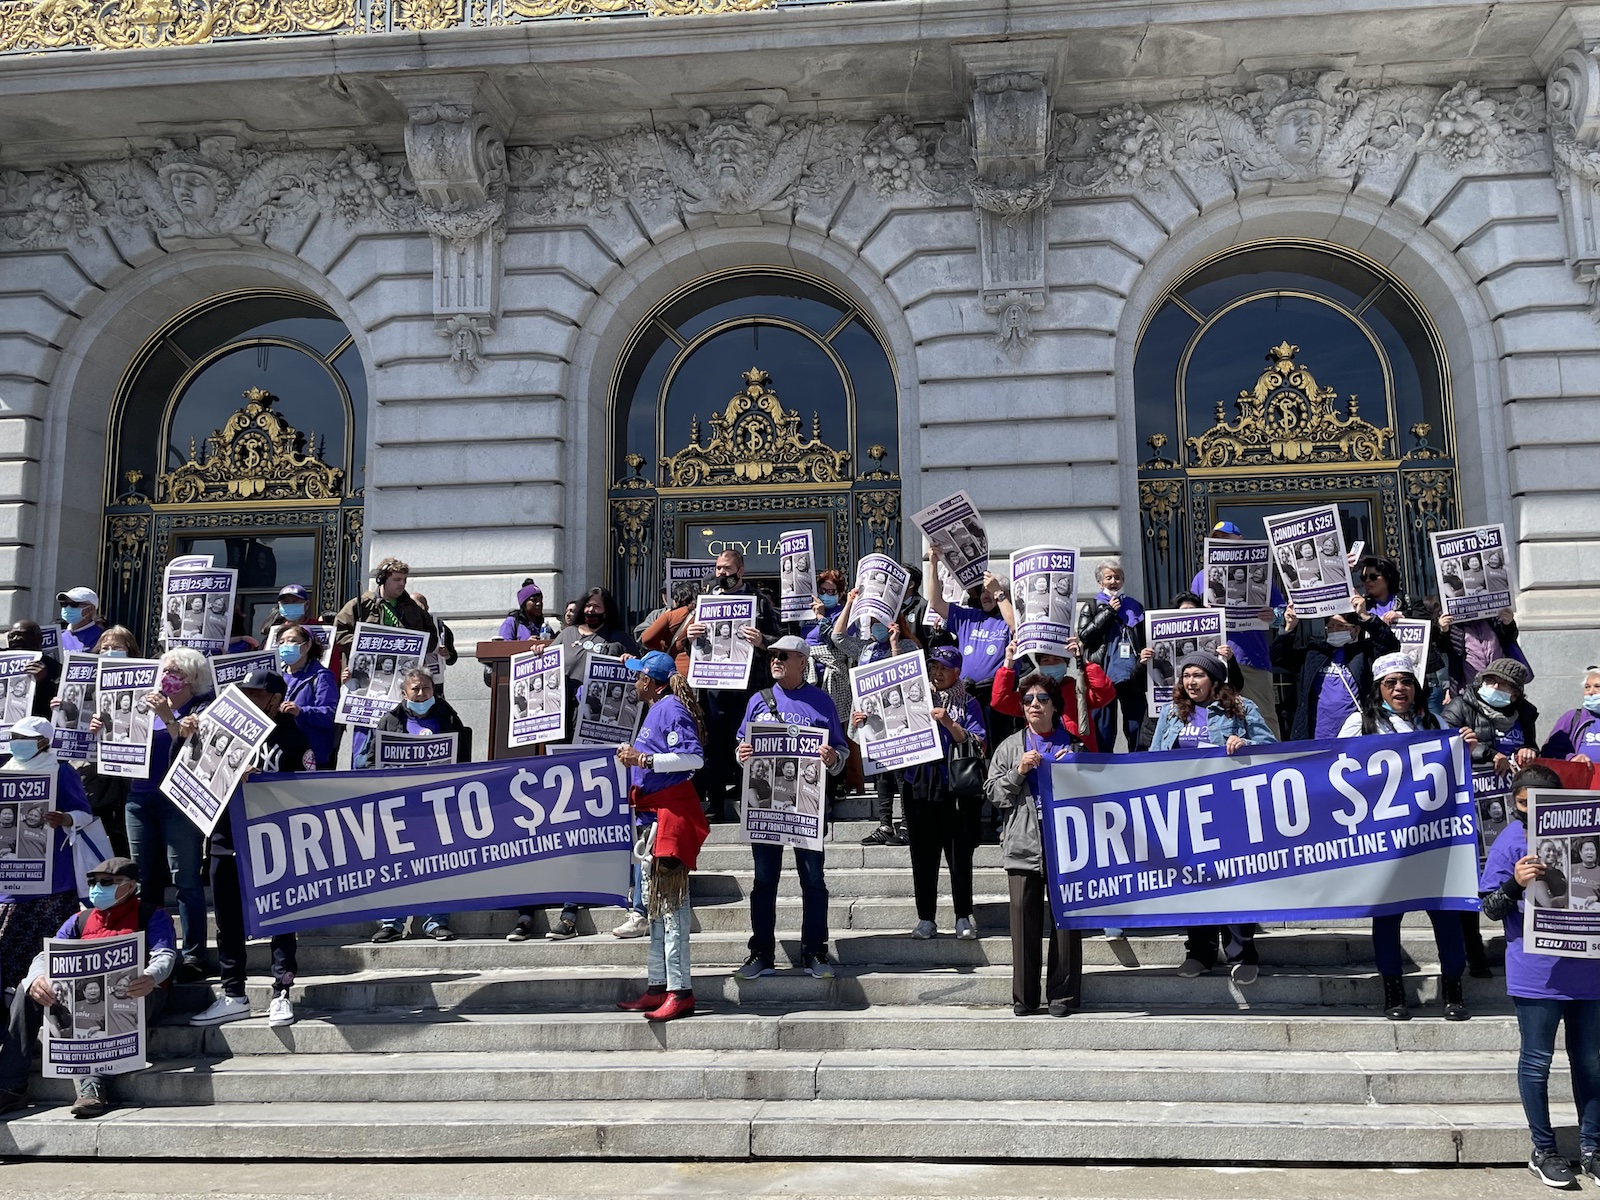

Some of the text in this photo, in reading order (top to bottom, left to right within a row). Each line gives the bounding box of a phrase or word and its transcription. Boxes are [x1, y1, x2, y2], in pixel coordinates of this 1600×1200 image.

[1273, 515, 1333, 544] ¡CONDUCE A $25!
[708, 540, 751, 556] CITY
[757, 540, 781, 555] HA
[792, 539, 806, 552] $25!
[1440, 533, 1498, 555] DRIVE TO $25!
[1210, 548, 1267, 563] ¡CONDUCE A $25!
[673, 568, 700, 577] DRIVE TO
[1015, 555, 1071, 577] DRIVE TO $25!
[701, 603, 749, 618] DRIVE TO $25!
[1153, 617, 1218, 638] ¡CONDUCE A $25!
[1403, 628, 1422, 642] $25!
[516, 654, 558, 677] DRIVE TO $25!
[593, 665, 626, 679] DRIVE TO
[102, 670, 154, 687] DRIVE TO $25!
[860, 661, 918, 692] DRIVE TO $25!
[212, 700, 263, 741] DRIVE TO $25!
[785, 712, 811, 727] 2015
[384, 743, 449, 760] DRIVE TO $25!
[755, 737, 783, 753] DRIVE
[785, 738, 797, 752] TO
[906, 754, 919, 762] seiu
[2, 781, 45, 799] TO $25!
[1498, 775, 1504, 789] A
[1053, 734, 1471, 875] DRIVE TO $25!
[246, 755, 630, 888] DRIVE TO $25!
[749, 810, 758, 818] SAN
[1538, 808, 1592, 834] ¡CONDUCE
[748, 821, 759, 829] LIFT
[768, 823, 794, 833] FRONTLINE
[794, 827, 817, 837] WORKERS
[1059, 815, 1473, 904] WE CAN'T HELP S.F. WITHOUT FRONTLINE WORKERS
[255, 824, 631, 915] WE CAN'T HELP S.F. WITHOUT FRONTLINE WORKERS
[52, 946, 133, 974] DRIVE TO $25!
[117, 1038, 136, 1047] POVERTY
[82, 1052, 96, 1060] PAYS
[96, 1049, 119, 1059] POVERTY
[119, 1046, 136, 1055] WAGES
[94, 1065, 113, 1073] seiu
